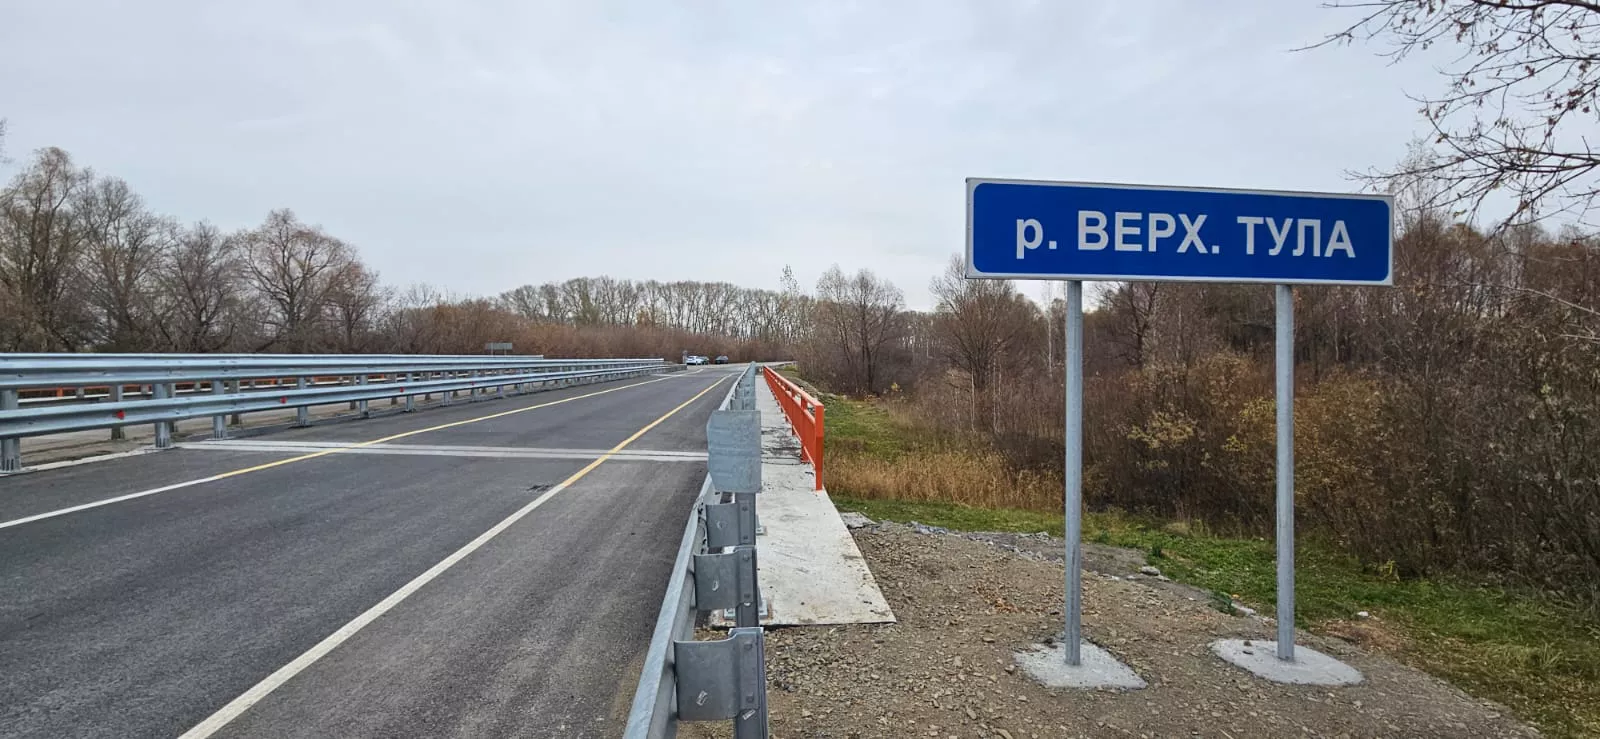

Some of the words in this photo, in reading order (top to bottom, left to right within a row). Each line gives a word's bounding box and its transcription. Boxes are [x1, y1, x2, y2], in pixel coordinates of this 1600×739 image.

[1016, 218, 1057, 259] р.
[1078, 210, 1220, 254] ВЕРХ.
[1237, 216, 1355, 258] ТУЛА
